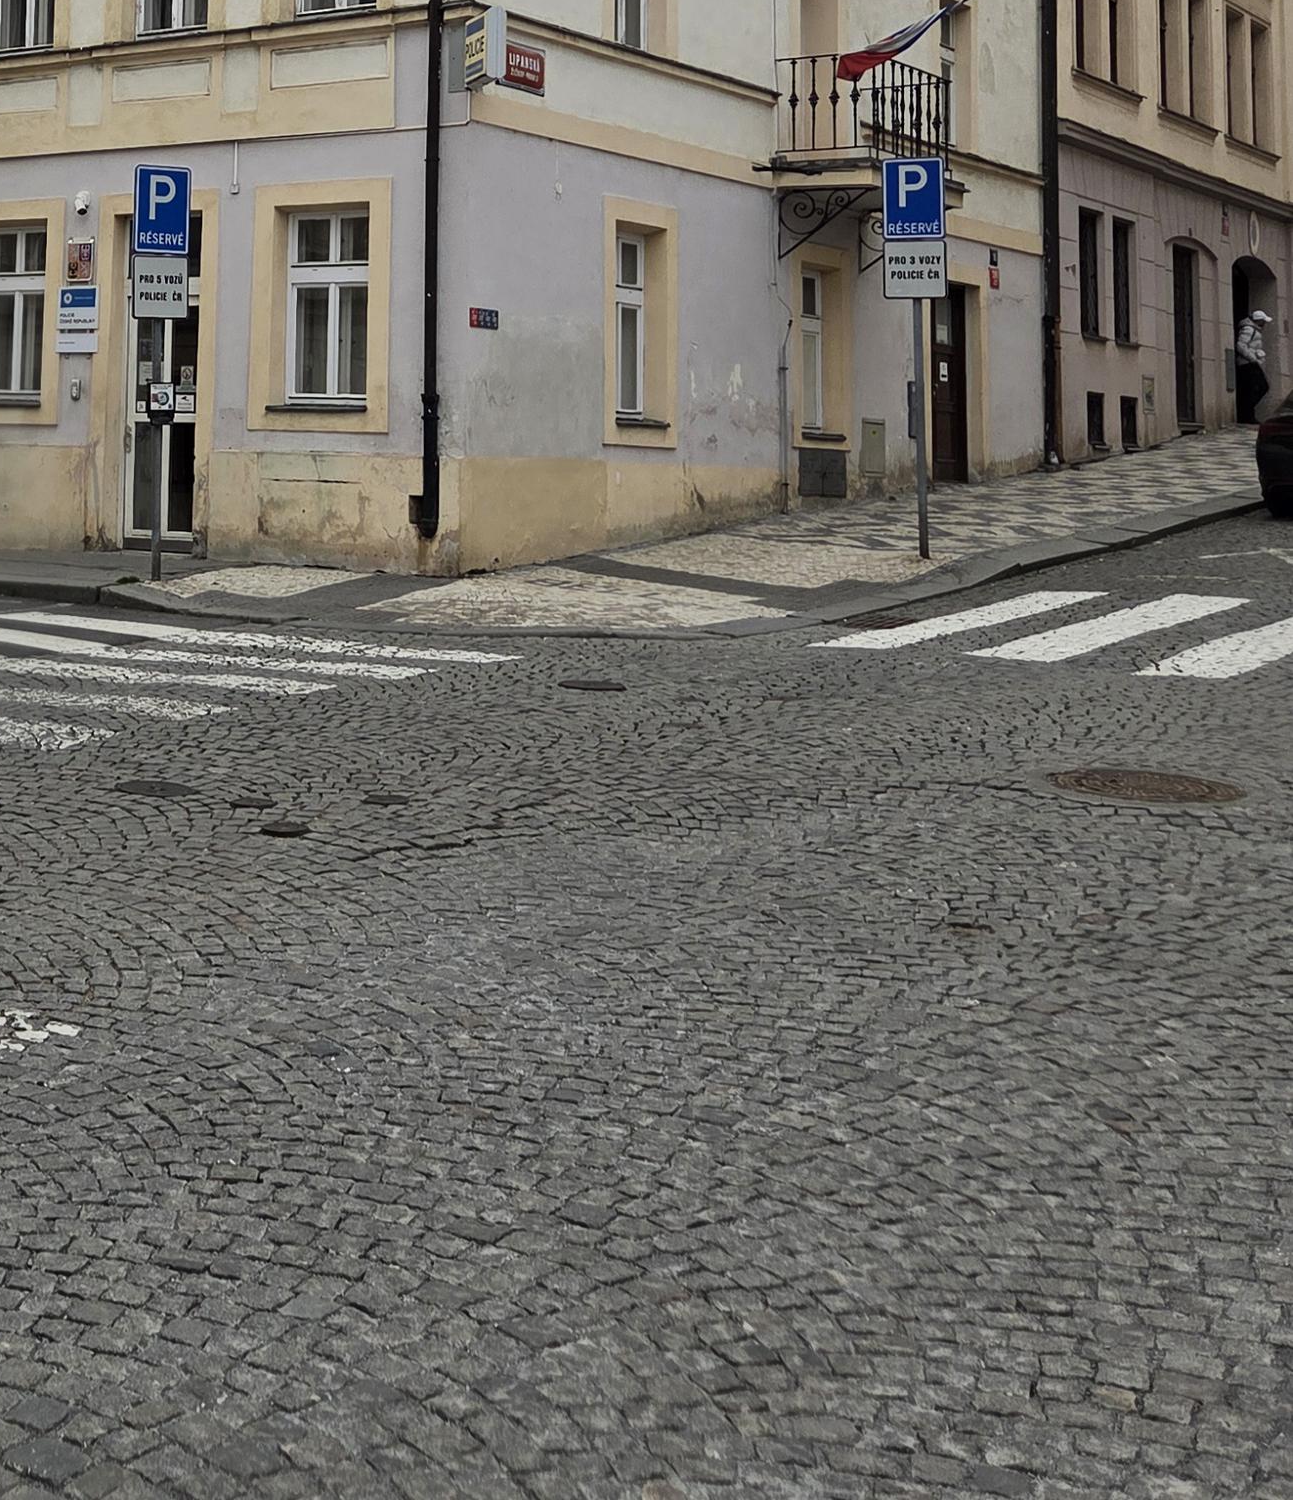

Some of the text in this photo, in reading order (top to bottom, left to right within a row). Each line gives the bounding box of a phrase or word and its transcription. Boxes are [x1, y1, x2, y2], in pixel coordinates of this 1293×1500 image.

[898, 164, 928, 208] P
[148, 174, 176, 220] P
[888, 219, 940, 234] RÉSERVÉ
[139, 230, 184, 246] RÉSERVÉ
[888, 255, 941, 265] PRO 3 VOZY
[139, 272, 183, 285] PRO 5 VOZŮ
[890, 268, 940, 280] POLICIE ČR
[139, 290, 182, 302] POLICIE ČR
